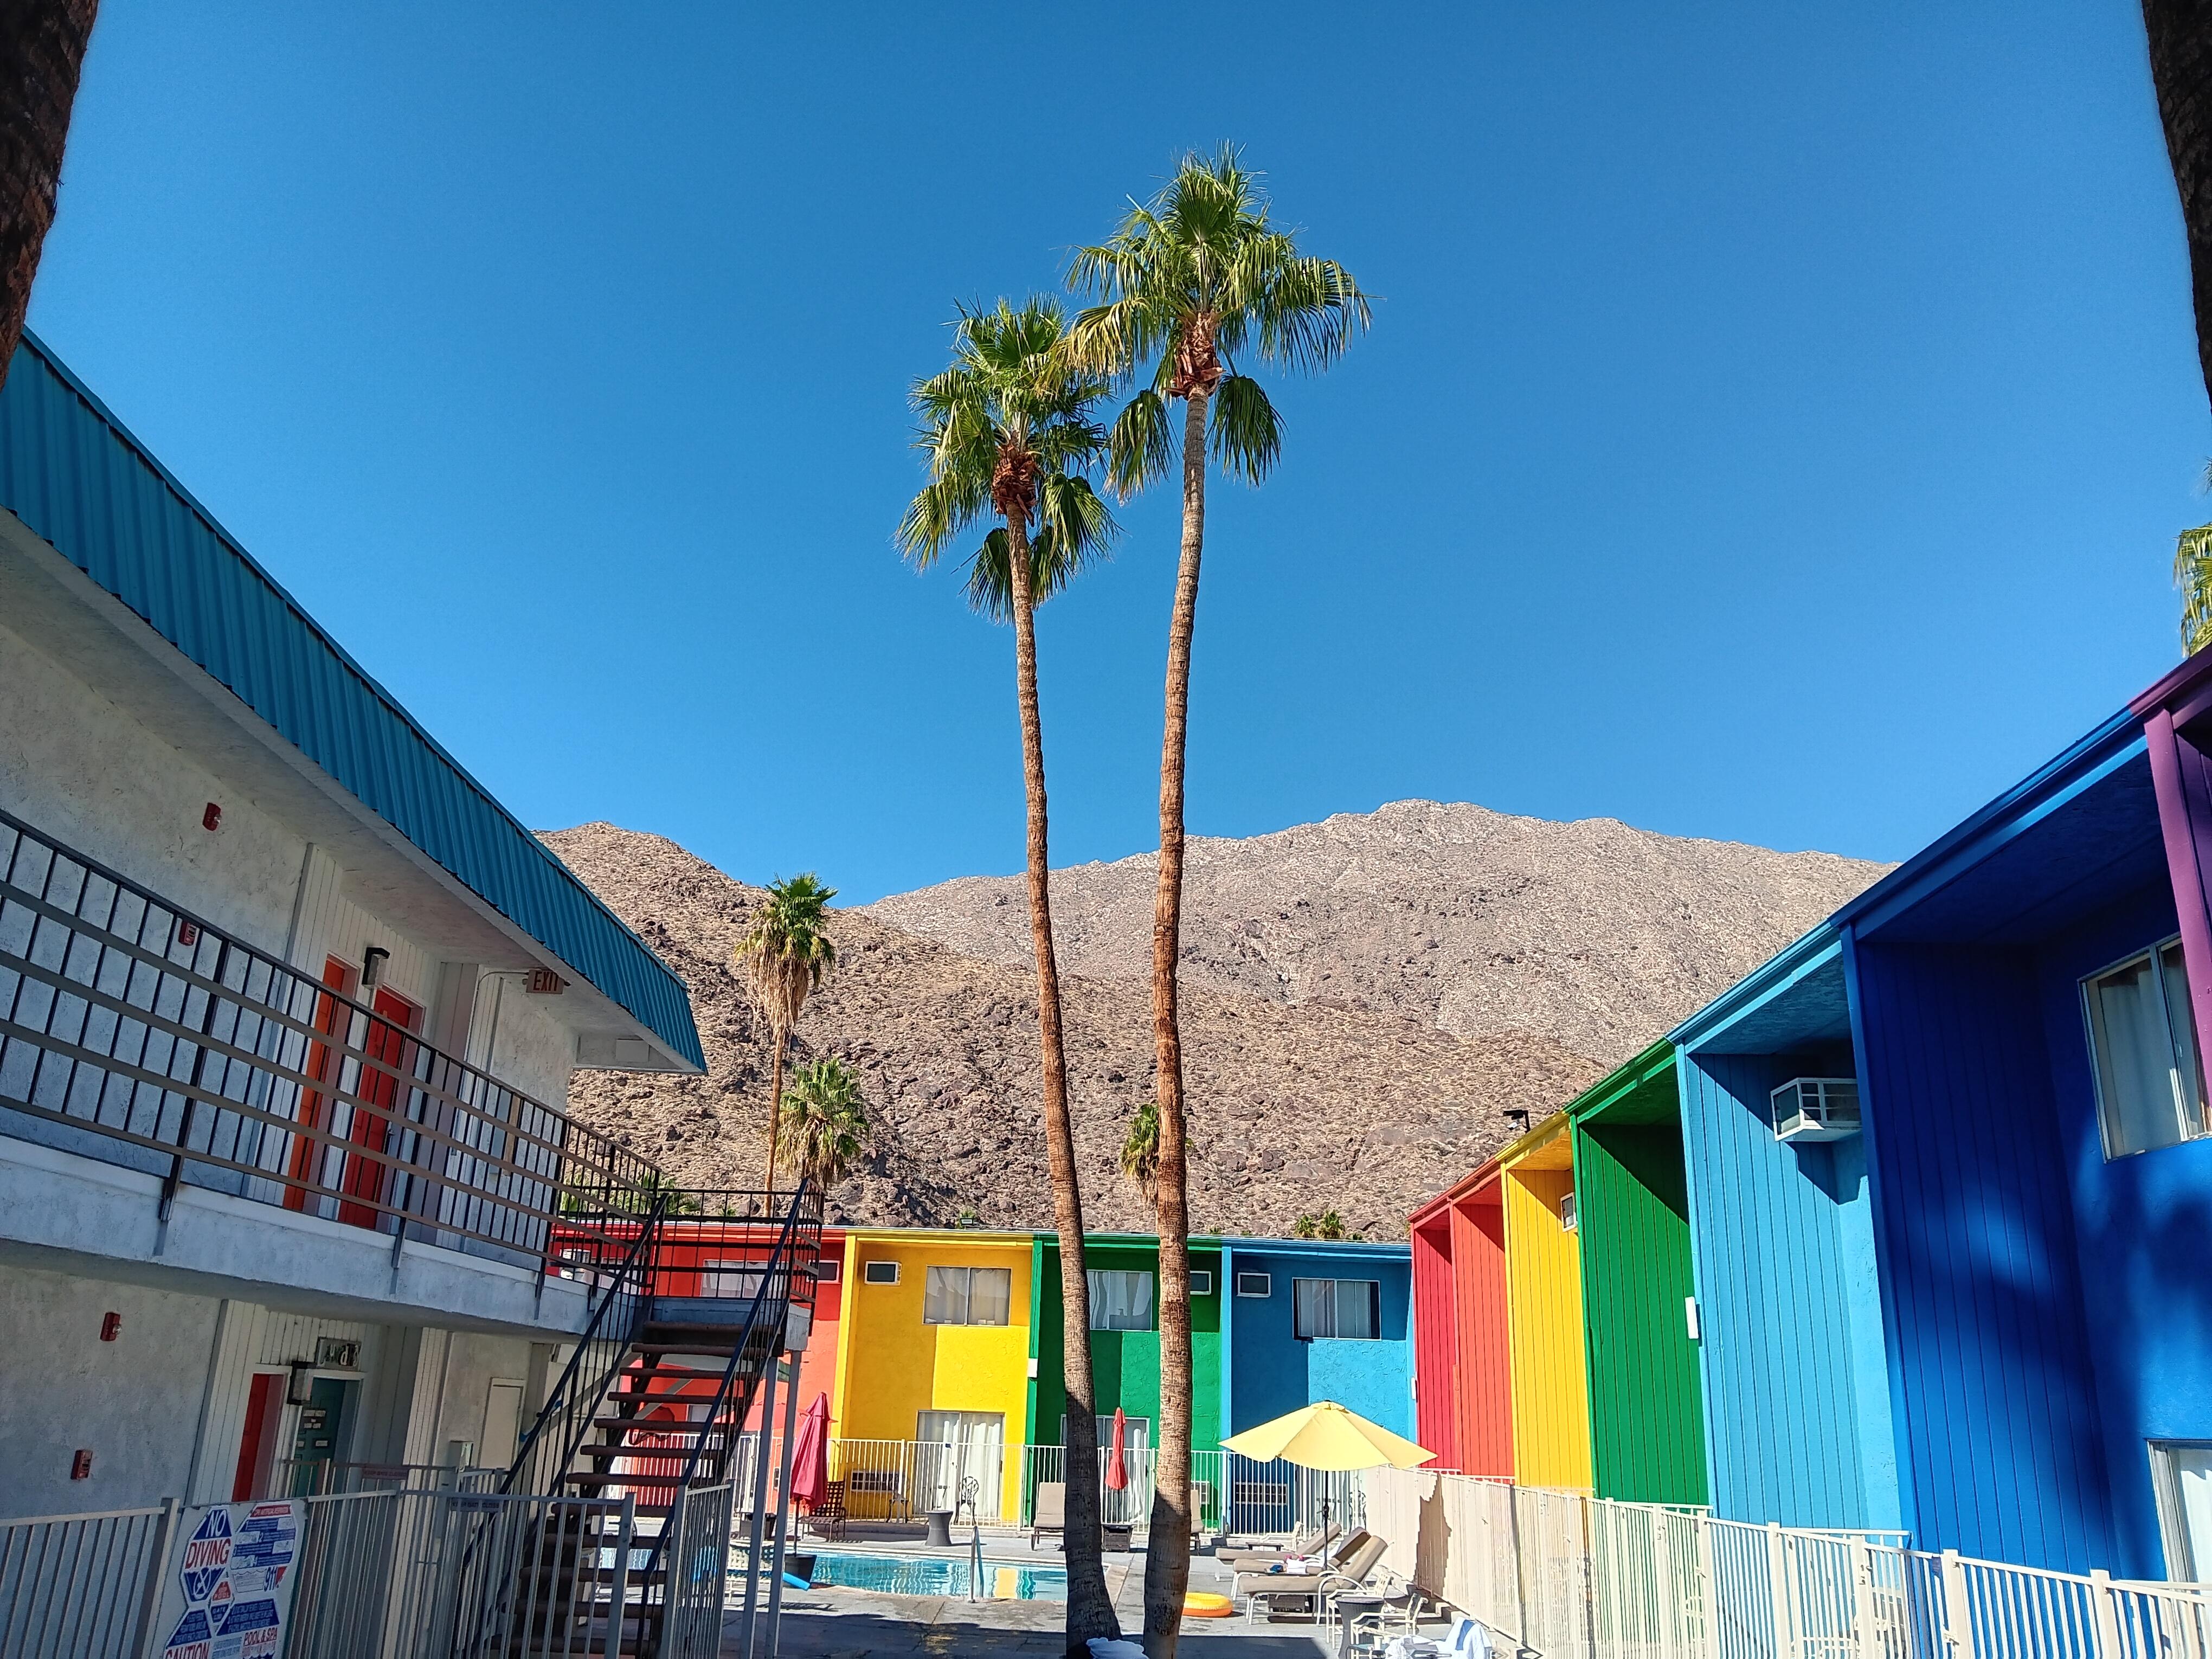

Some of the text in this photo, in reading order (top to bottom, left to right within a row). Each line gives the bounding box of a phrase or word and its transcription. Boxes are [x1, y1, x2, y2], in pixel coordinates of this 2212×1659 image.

[533, 971, 559, 991] EXIT
[205, 1509, 227, 1538] NO
[259, 1532, 264, 1543] 2
[184, 1538, 231, 1570] DIVING
[264, 1566, 278, 1592] 911
[243, 1630, 261, 1645] POOL
[266, 1628, 278, 1641] SPA
